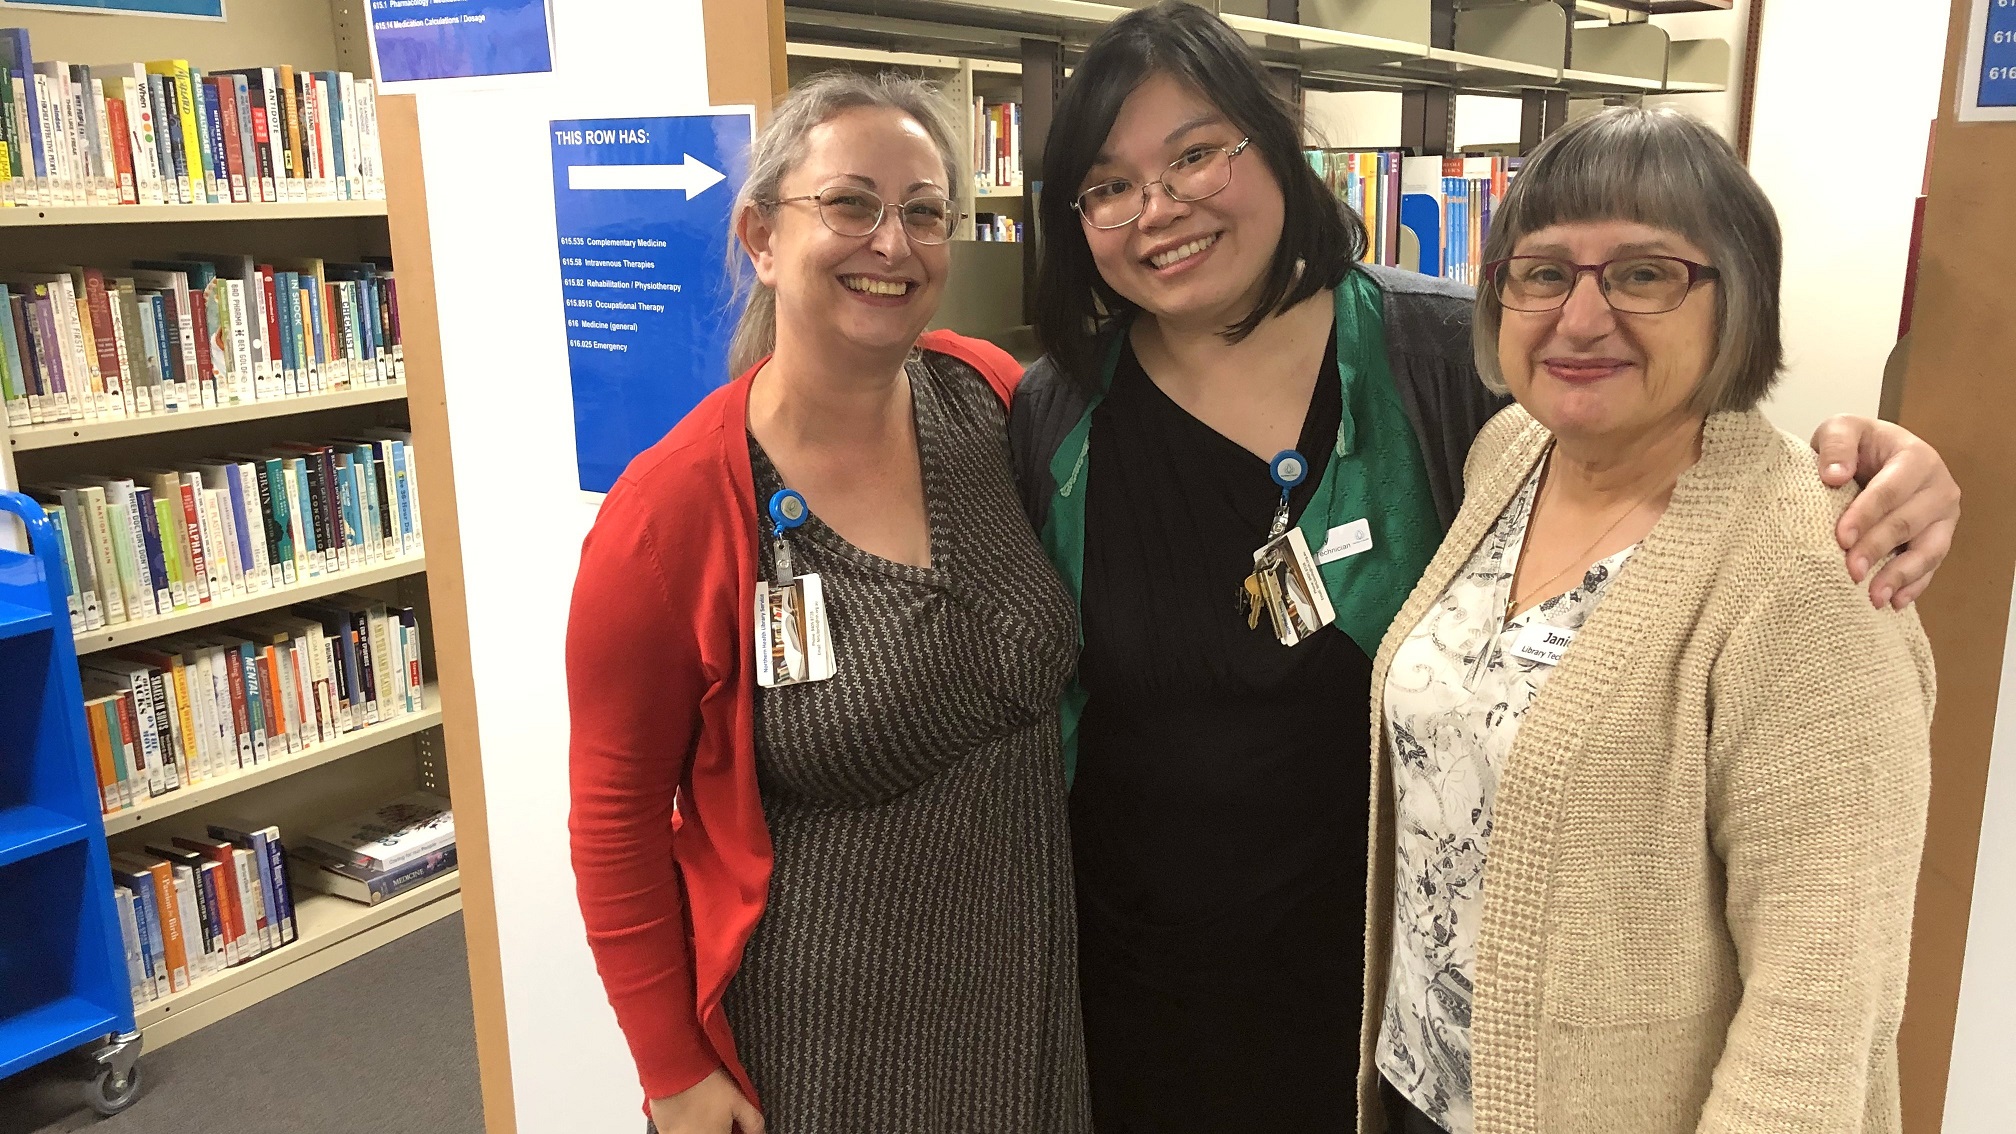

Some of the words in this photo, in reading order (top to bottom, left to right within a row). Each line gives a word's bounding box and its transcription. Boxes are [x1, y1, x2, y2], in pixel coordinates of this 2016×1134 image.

[372, 1, 387, 9] 615.1
[375, 22, 393, 30] 615.14
[394, 19, 423, 29] Medication
[425, 17, 459, 26] Calculations
[463, 14, 486, 24] Dosage
[138, 83, 148, 108] When
[53, 104, 62, 132] mindset
[194, 73, 202, 102] DEADLY
[198, 104, 210, 154] HEALTHCARE
[228, 98, 238, 137] Cautionary
[268, 88, 279, 134] ANTIDOTE
[555, 131, 582, 145] THIS
[585, 130, 615, 144] ROW
[619, 129, 650, 144] HAS:
[561, 237, 584, 245] 615.535
[587, 238, 636, 248] Complementary
[638, 239, 667, 248] Medicine
[562, 258, 582, 266] 615.58
[585, 259, 622, 267] Intravenous
[623, 260, 655, 269] Therapies
[231, 284, 239, 297] BAD
[292, 279, 298, 289] IN
[587, 279, 630, 288] Rehabilitation
[635, 281, 681, 292] Physiotherapy
[233, 299, 242, 326] PHARMA
[292, 292, 302, 325] SHOCK
[595, 301, 637, 310] Occupational
[638, 303, 664, 313] Therapy
[67, 289, 77, 326] MEDICAL
[74, 327, 83, 354] FIRSTS
[342, 302, 353, 350] CHECKLIST
[582, 320, 608, 329] Medicine
[610, 322, 638, 332] (general)
[594, 341, 628, 352] Emergency
[259, 472, 270, 505] BRAIN
[401, 490, 409, 519] 36-Hour
[97, 506, 105, 534] NATION
[129, 492, 137, 513] WHEN
[133, 515, 143, 548] DOCTORS
[139, 549, 147, 570] DON'T
[311, 495, 325, 552] CONCUSSIO
[189, 523, 201, 554] ALPHA
[229, 650, 240, 677] Finding
[1521, 645, 1546, 658] Library
[151, 676, 164, 702] SNAKES
[233, 678, 242, 700] Sanity
[245, 656, 258, 696] MENTAL
[134, 675, 147, 715] SACKS
[142, 678, 151, 708] OLIVER
[148, 716, 154, 729] ON
[157, 711, 168, 730] SUITS
[150, 732, 158, 752] THE
[392, 868, 425, 887] MEDICINE
[162, 879, 173, 909] Passion
[169, 918, 179, 941] Birth
